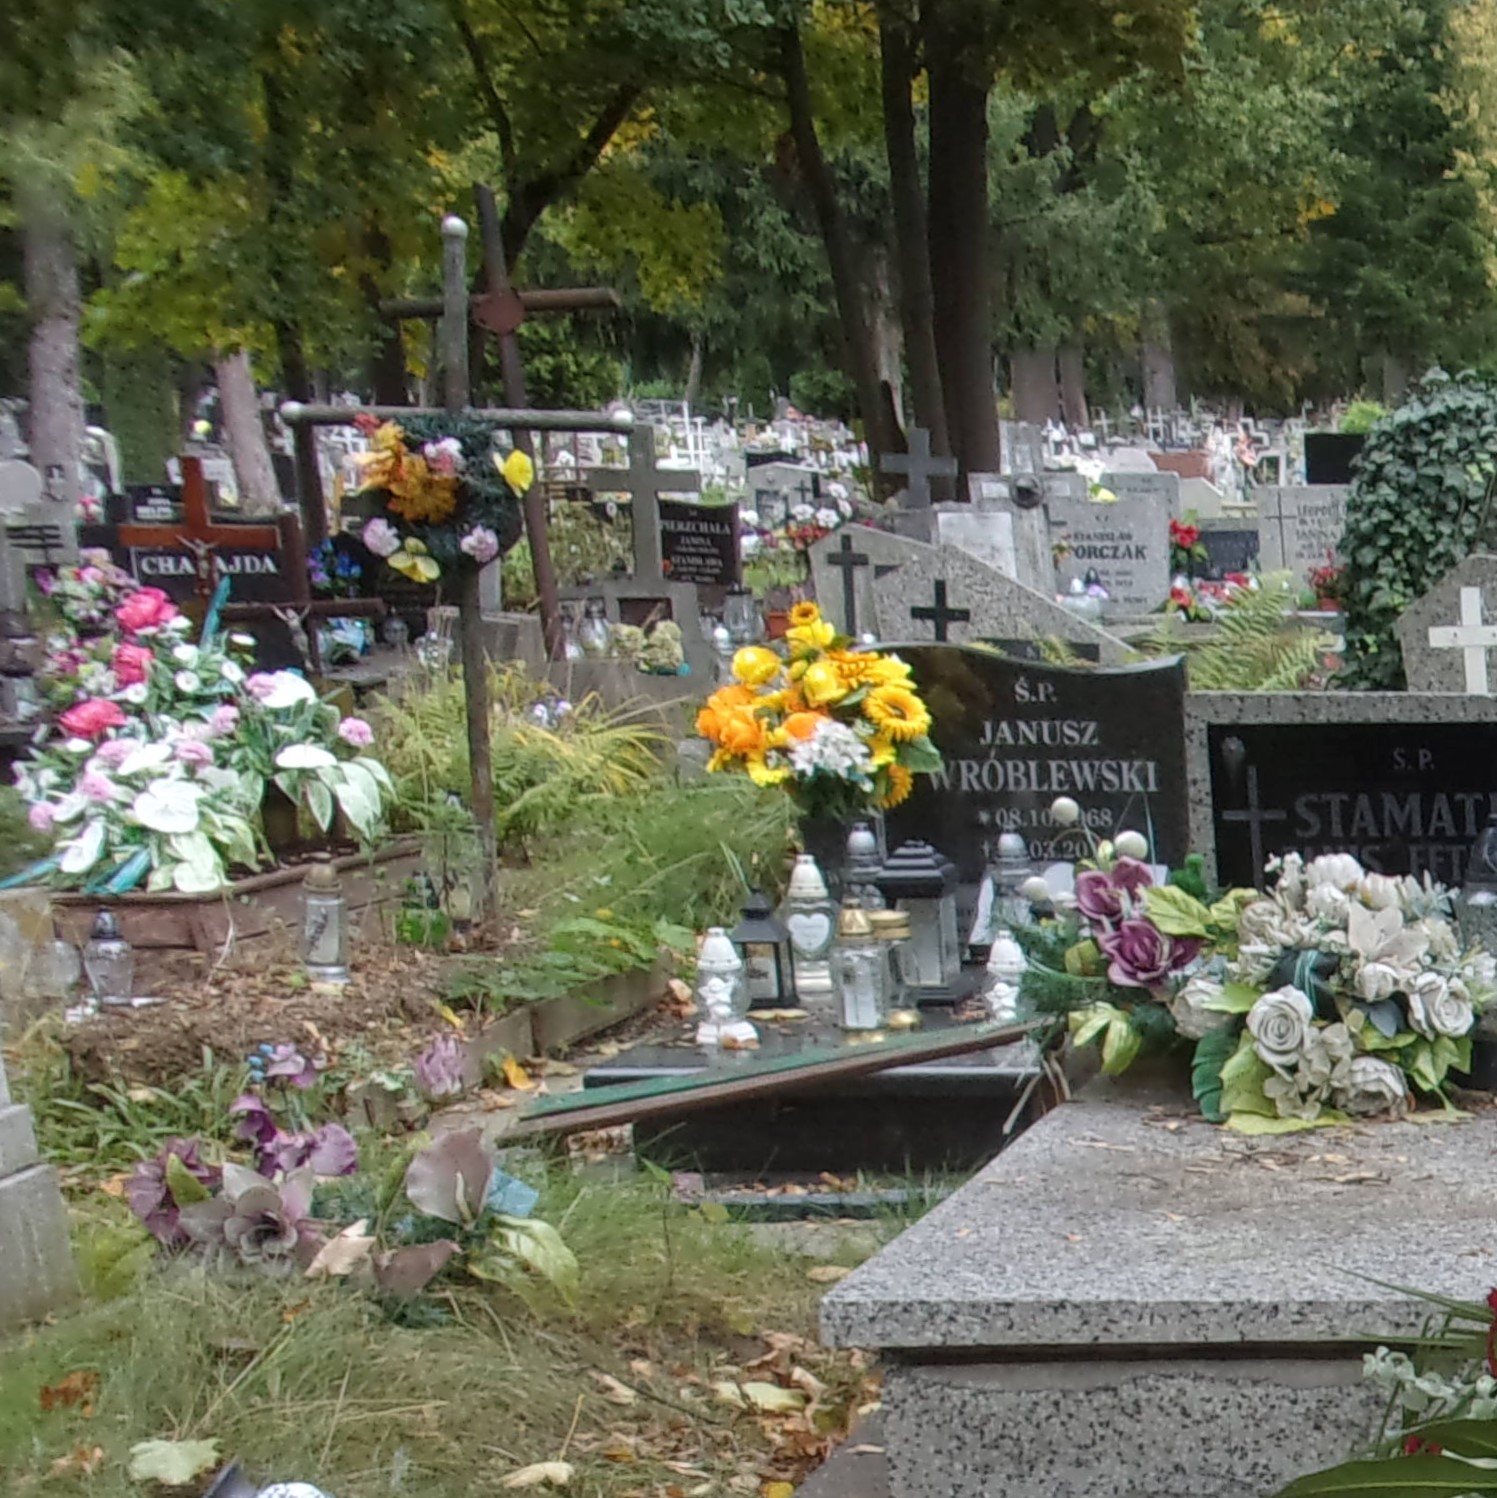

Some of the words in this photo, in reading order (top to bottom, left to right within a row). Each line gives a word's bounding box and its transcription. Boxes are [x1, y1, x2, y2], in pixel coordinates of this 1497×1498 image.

[140, 554, 279, 575] CHAAJDA
[979, 720, 1100, 746] JANUSZ
[927, 748, 1159, 793] WRÓBLEWSKI
